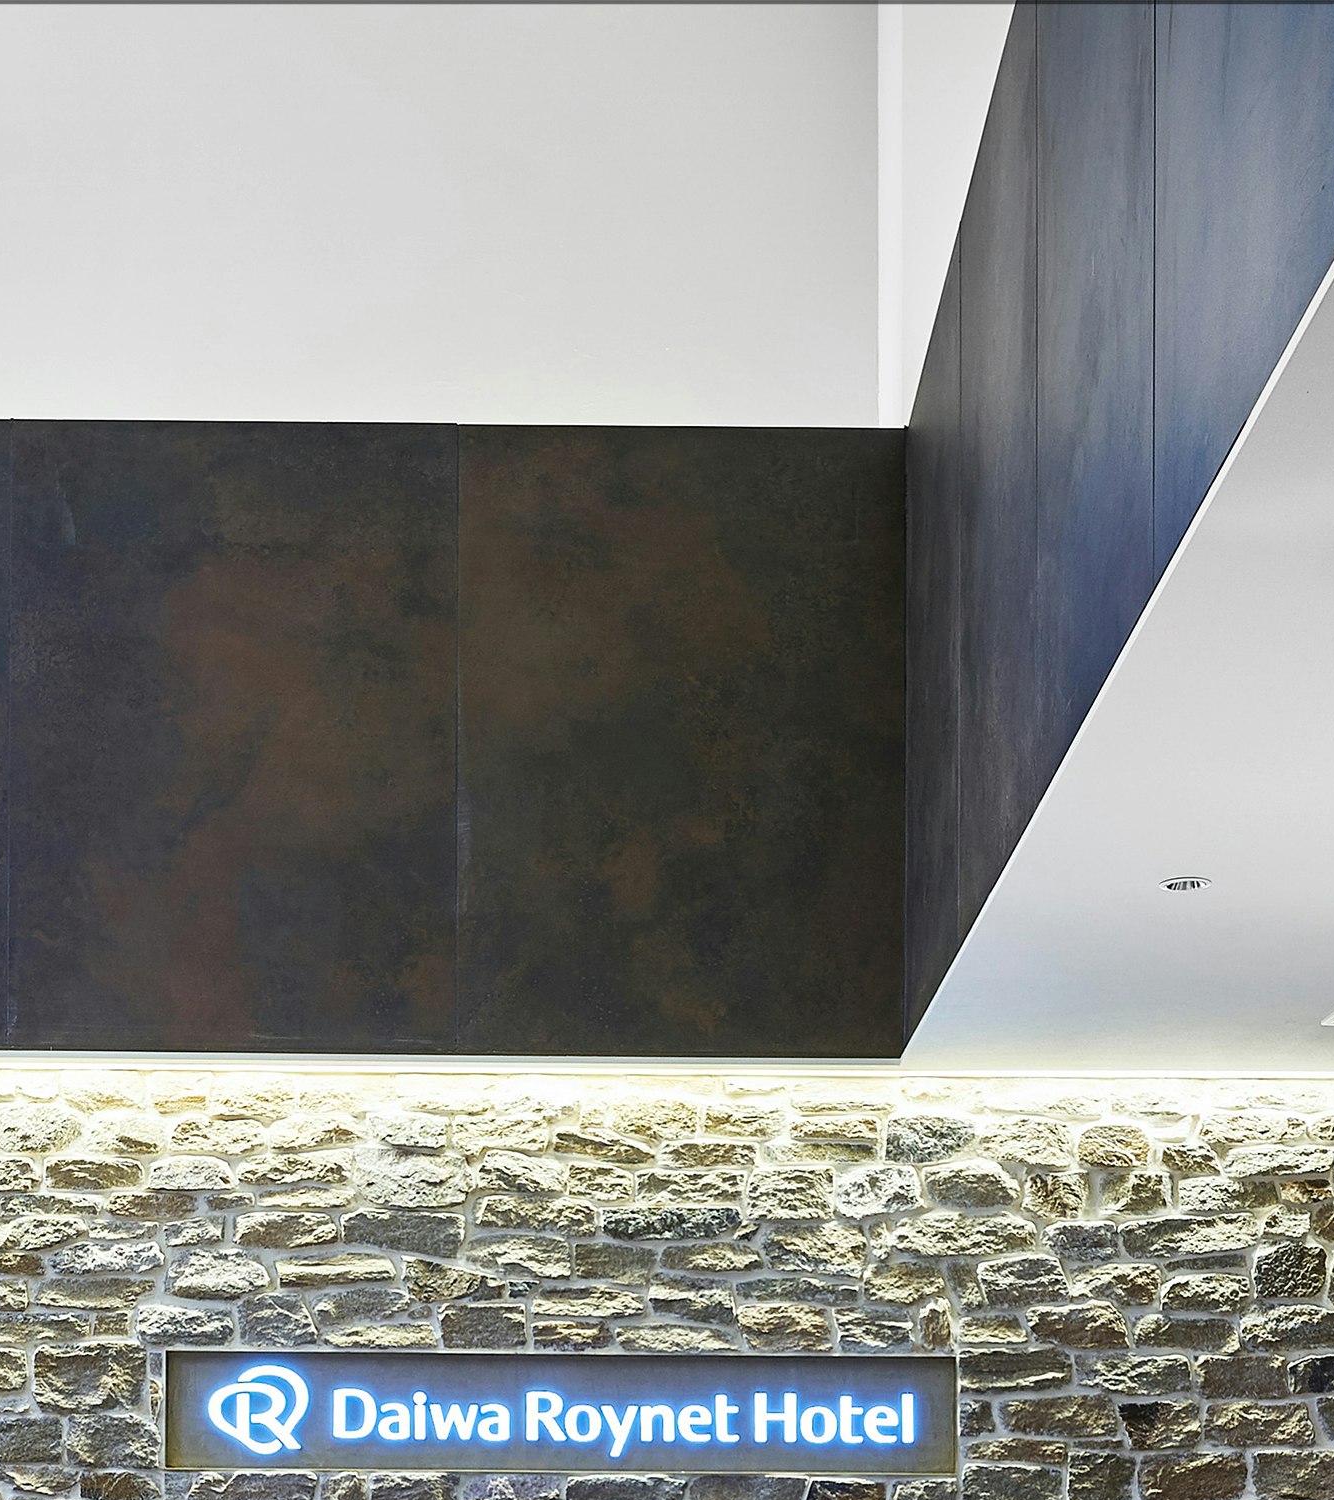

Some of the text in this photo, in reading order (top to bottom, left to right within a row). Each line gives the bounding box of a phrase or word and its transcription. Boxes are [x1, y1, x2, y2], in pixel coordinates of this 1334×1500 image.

[331, 1388, 915, 1459] Daiwa Roynet Hotel
